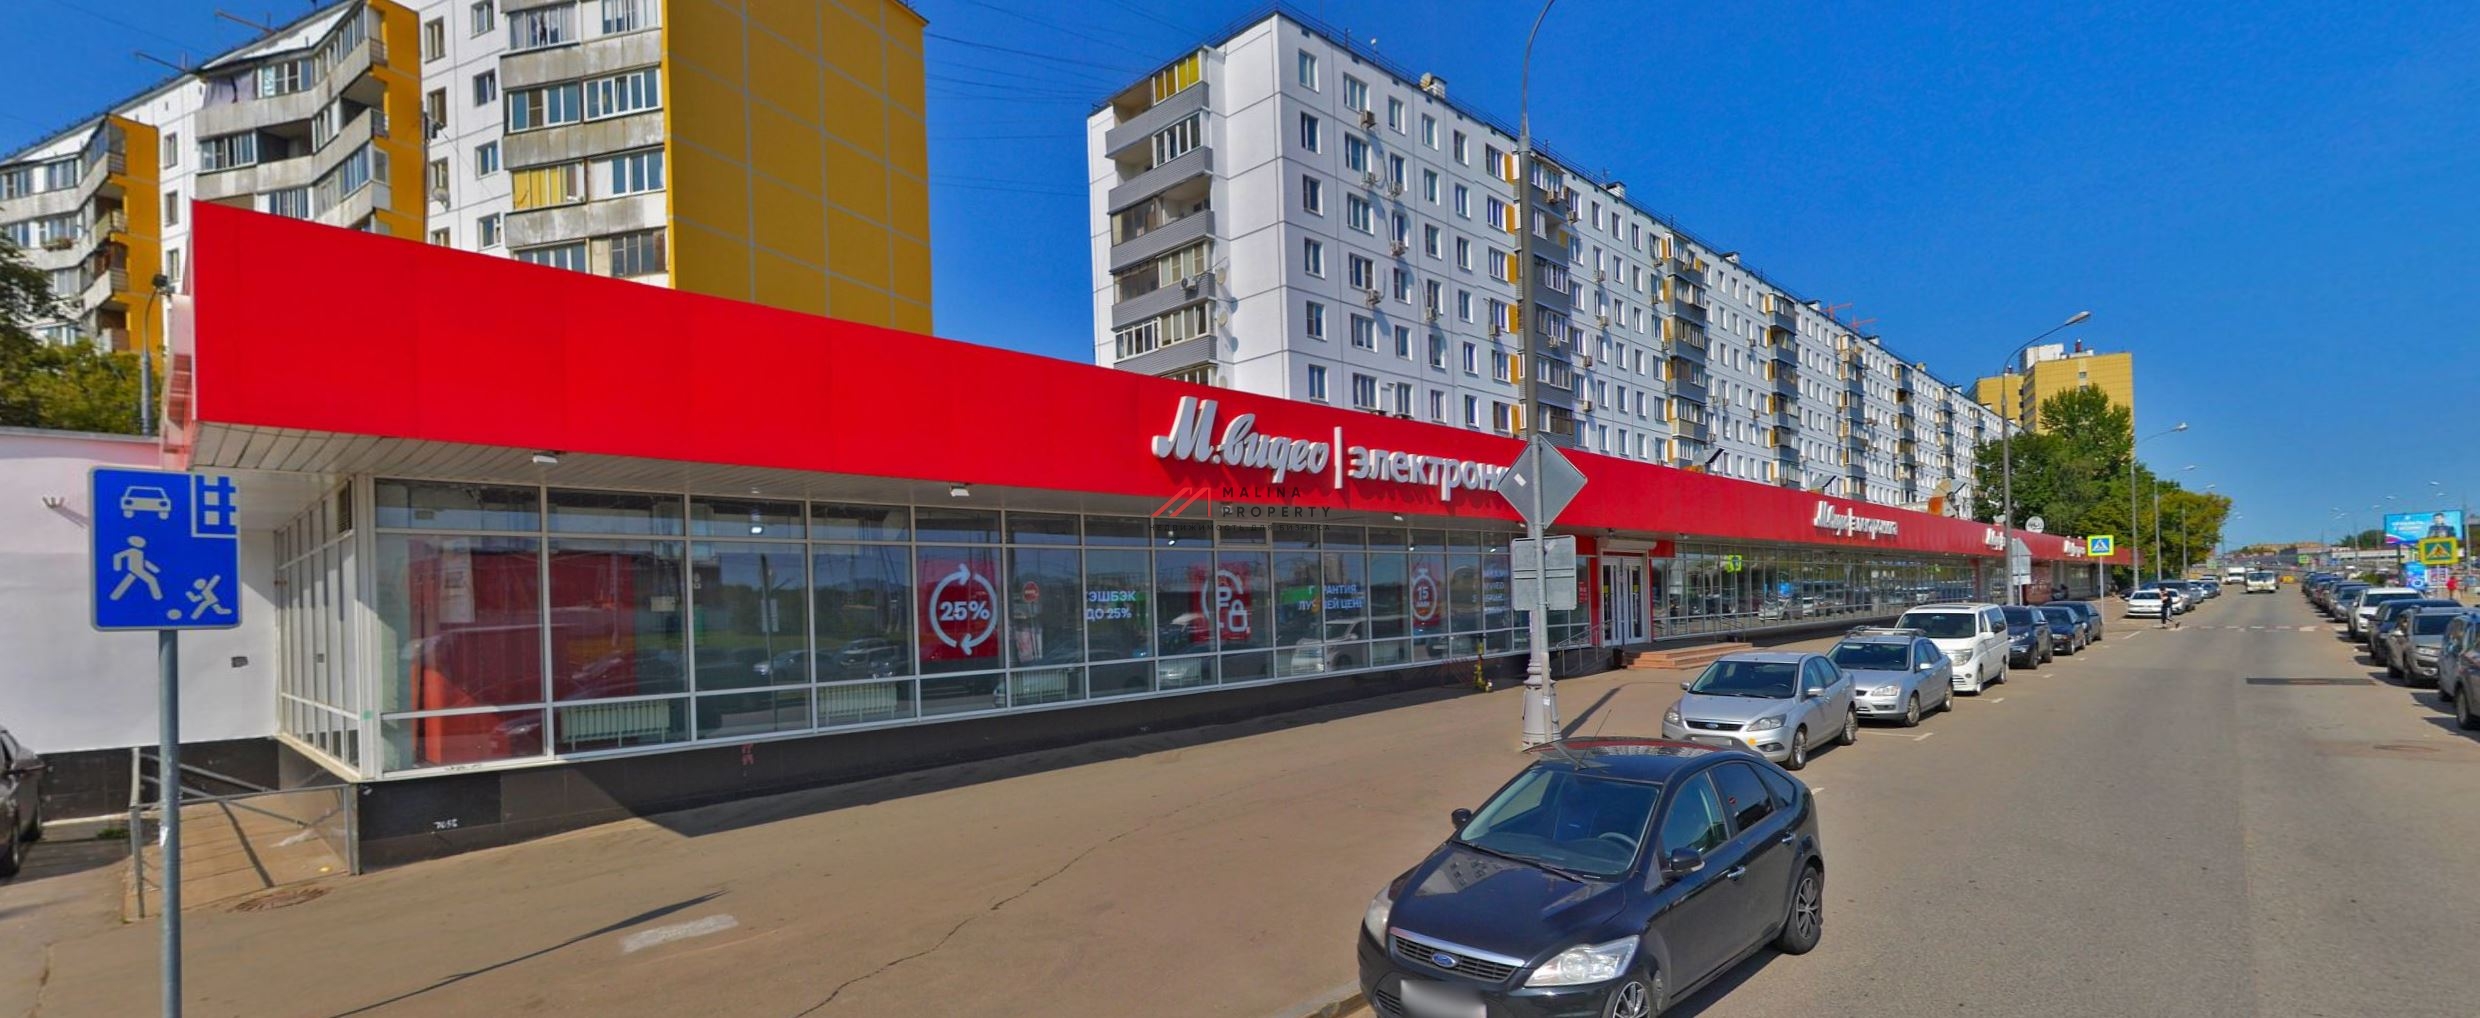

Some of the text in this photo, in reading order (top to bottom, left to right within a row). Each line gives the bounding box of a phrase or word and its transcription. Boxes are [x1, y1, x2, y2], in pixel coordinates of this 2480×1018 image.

[1152, 395, 1330, 484] М.видео
[1086, 590, 1136, 602] ЭШБЭК
[1417, 586, 1429, 601] 15
[940, 600, 991, 621] 25%
[1086, 607, 1132, 622] ДО 25%
